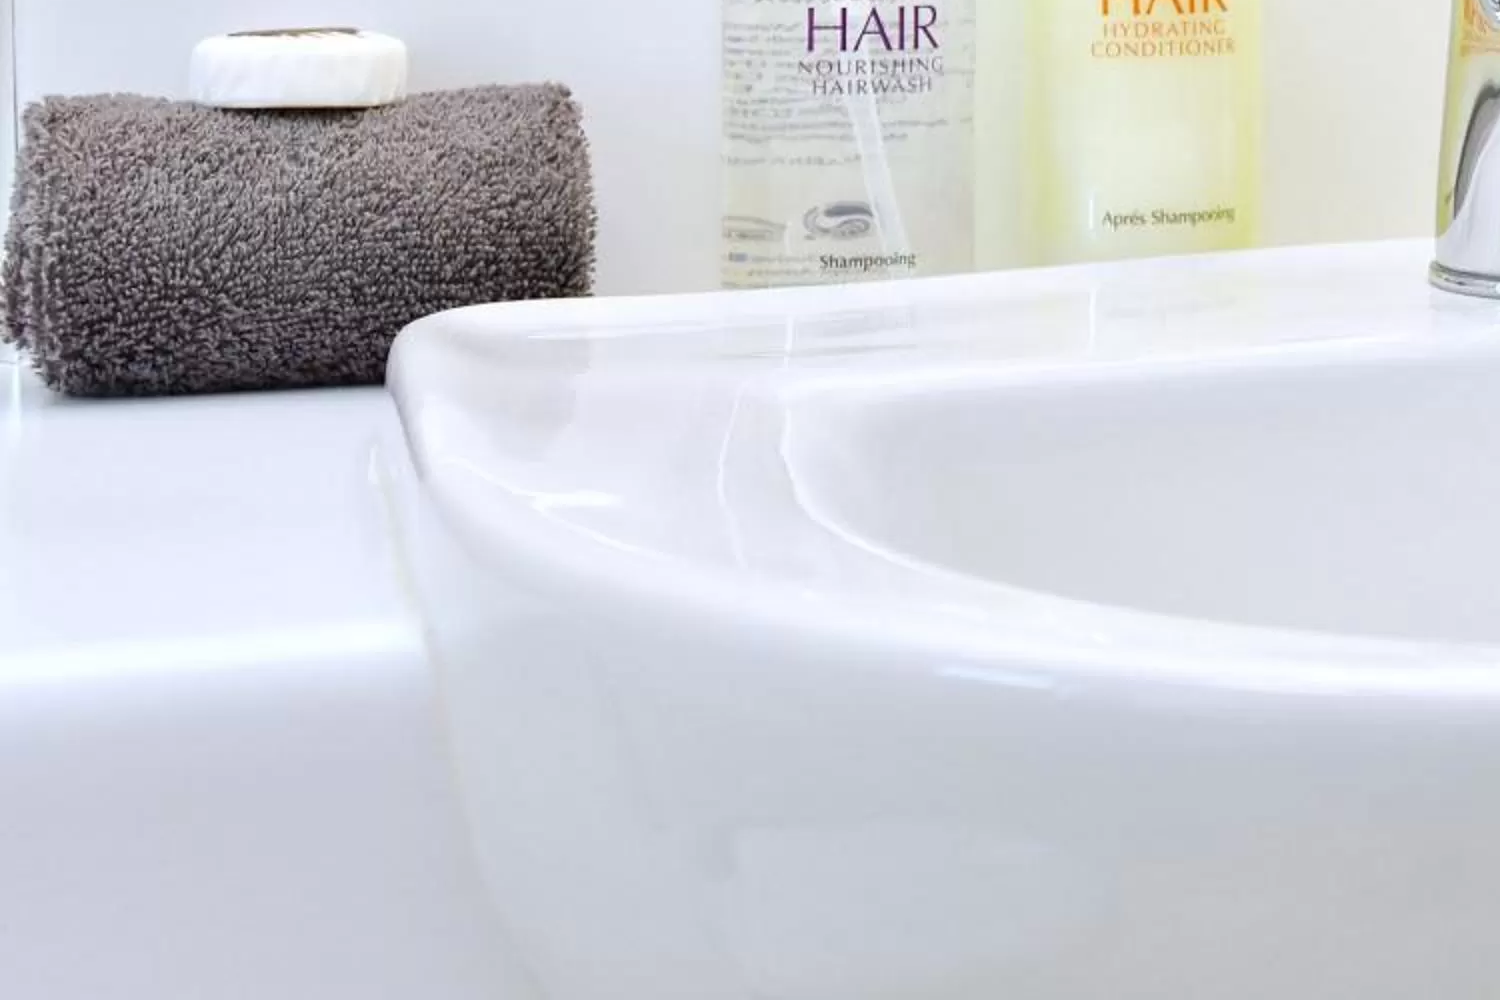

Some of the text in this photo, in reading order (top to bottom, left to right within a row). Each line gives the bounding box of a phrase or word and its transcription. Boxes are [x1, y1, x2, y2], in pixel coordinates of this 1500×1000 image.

[806, 3, 941, 53] HAIR
[1103, 18, 1227, 39] HYDRATING
[1091, 37, 1237, 58] CONDITIONER
[798, 55, 946, 80] NOURISHING
[812, 75, 933, 97] HAIRWASH
[1151, 203, 1237, 229] Shampooing
[819, 250, 917, 272] Shampooing
